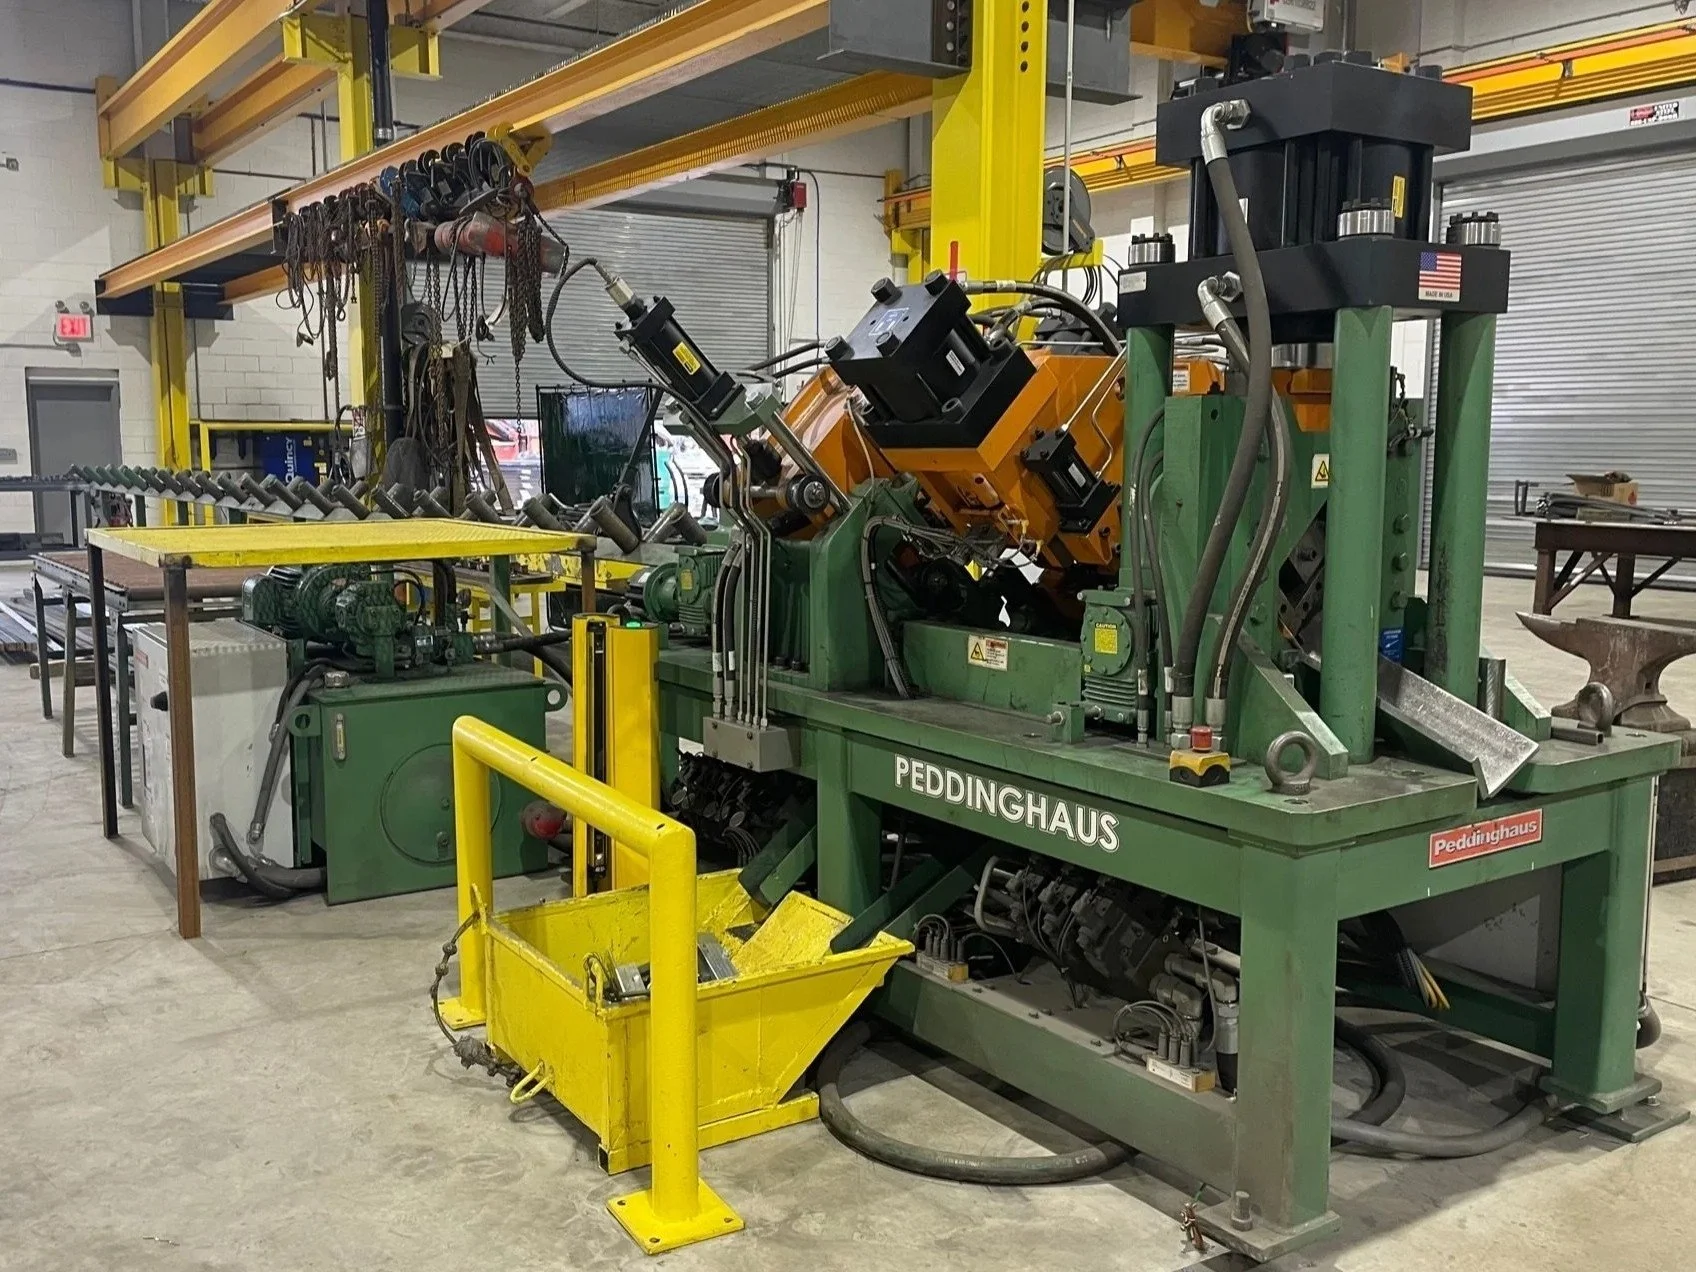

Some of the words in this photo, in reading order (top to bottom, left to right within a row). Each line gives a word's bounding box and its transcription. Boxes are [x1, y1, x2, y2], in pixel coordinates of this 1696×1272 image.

[61, 317, 87, 336] EXIT
[894, 753, 1120, 854] PEDDINGHAUS
[1434, 820, 1538, 857] Peddinghaus
